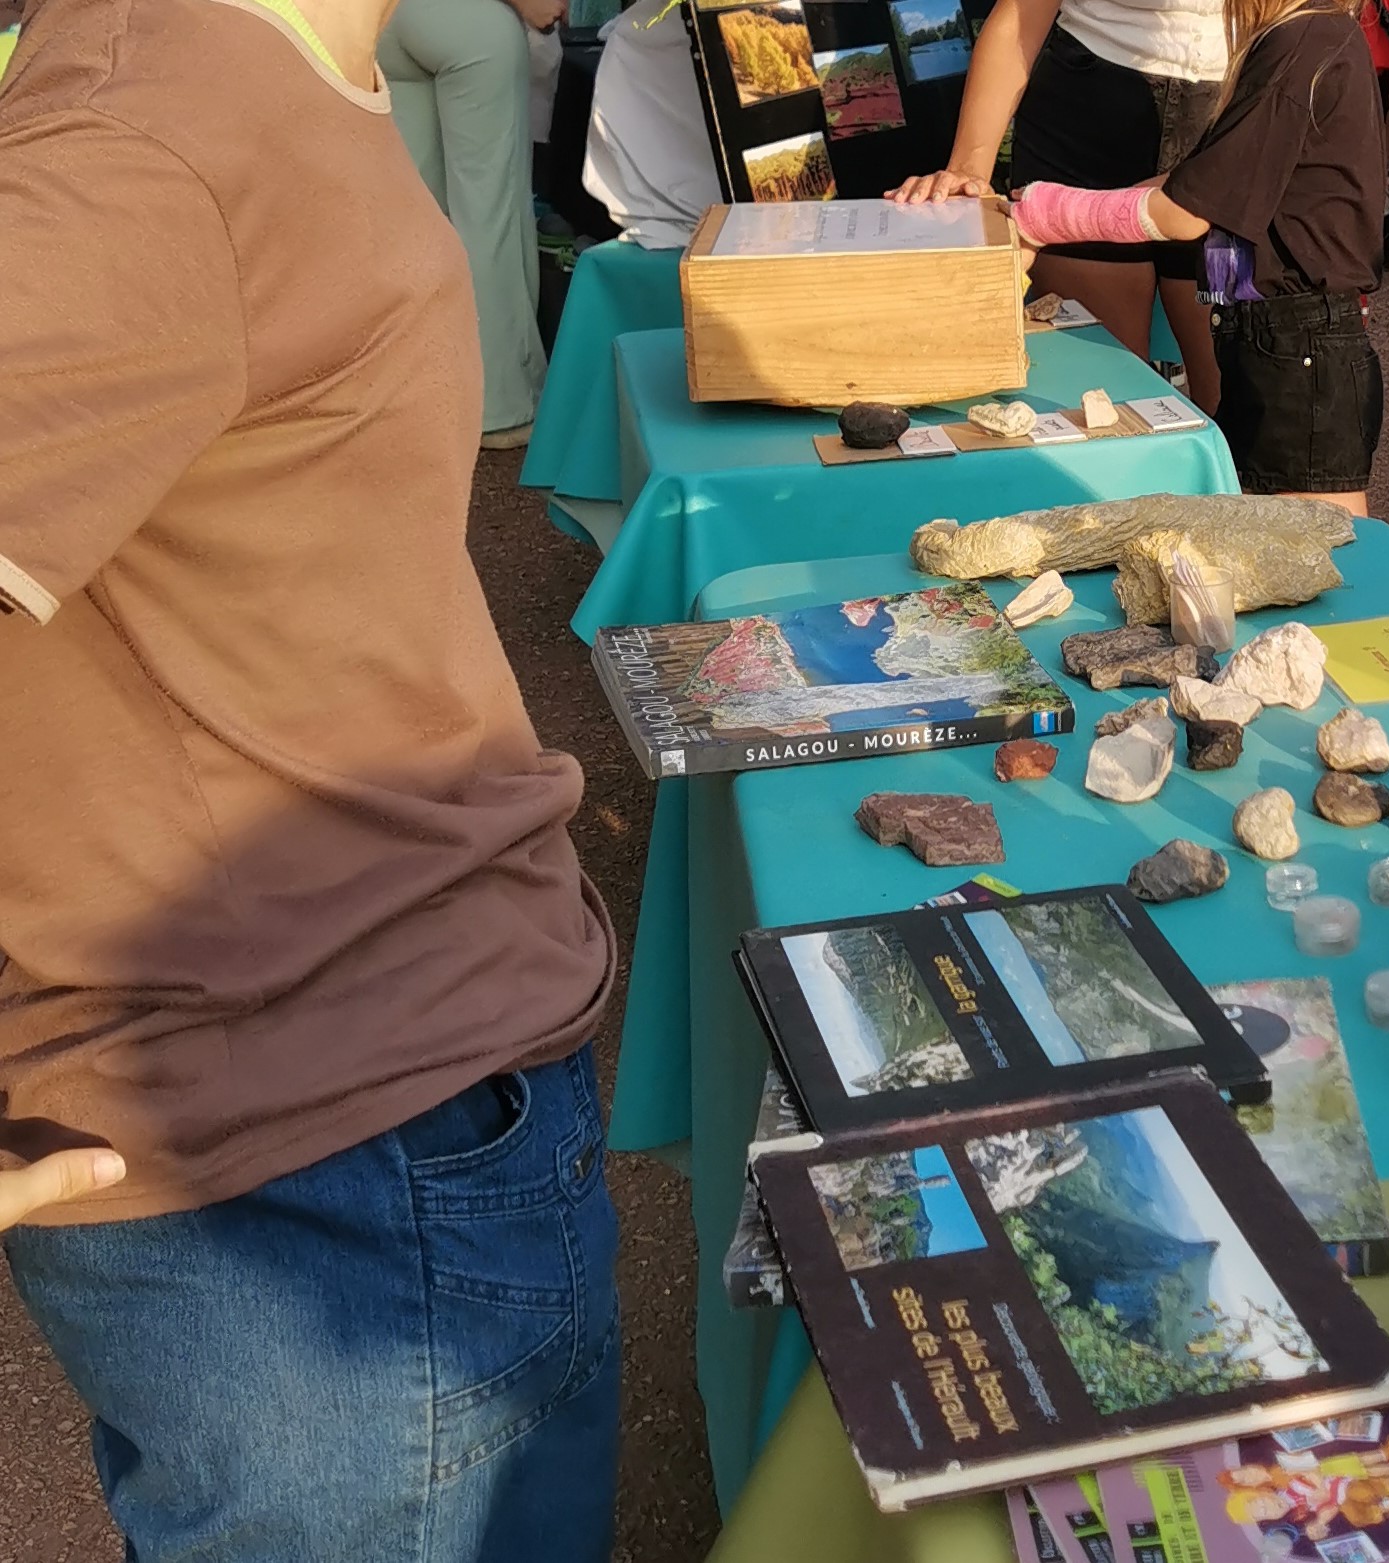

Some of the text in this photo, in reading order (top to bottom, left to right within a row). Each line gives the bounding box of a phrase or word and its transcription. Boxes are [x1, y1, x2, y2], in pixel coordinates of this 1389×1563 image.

[632, 696, 691, 745] SALAGOU
[745, 738, 839, 762] SALAGOU
[864, 726, 979, 750] MOURÈZE...
[932, 953, 976, 1000] garrigue
[954, 999, 979, 1013] la
[891, 1286, 980, 1441] sites de l'Hérault
[940, 1298, 1018, 1433] les plus beaux
